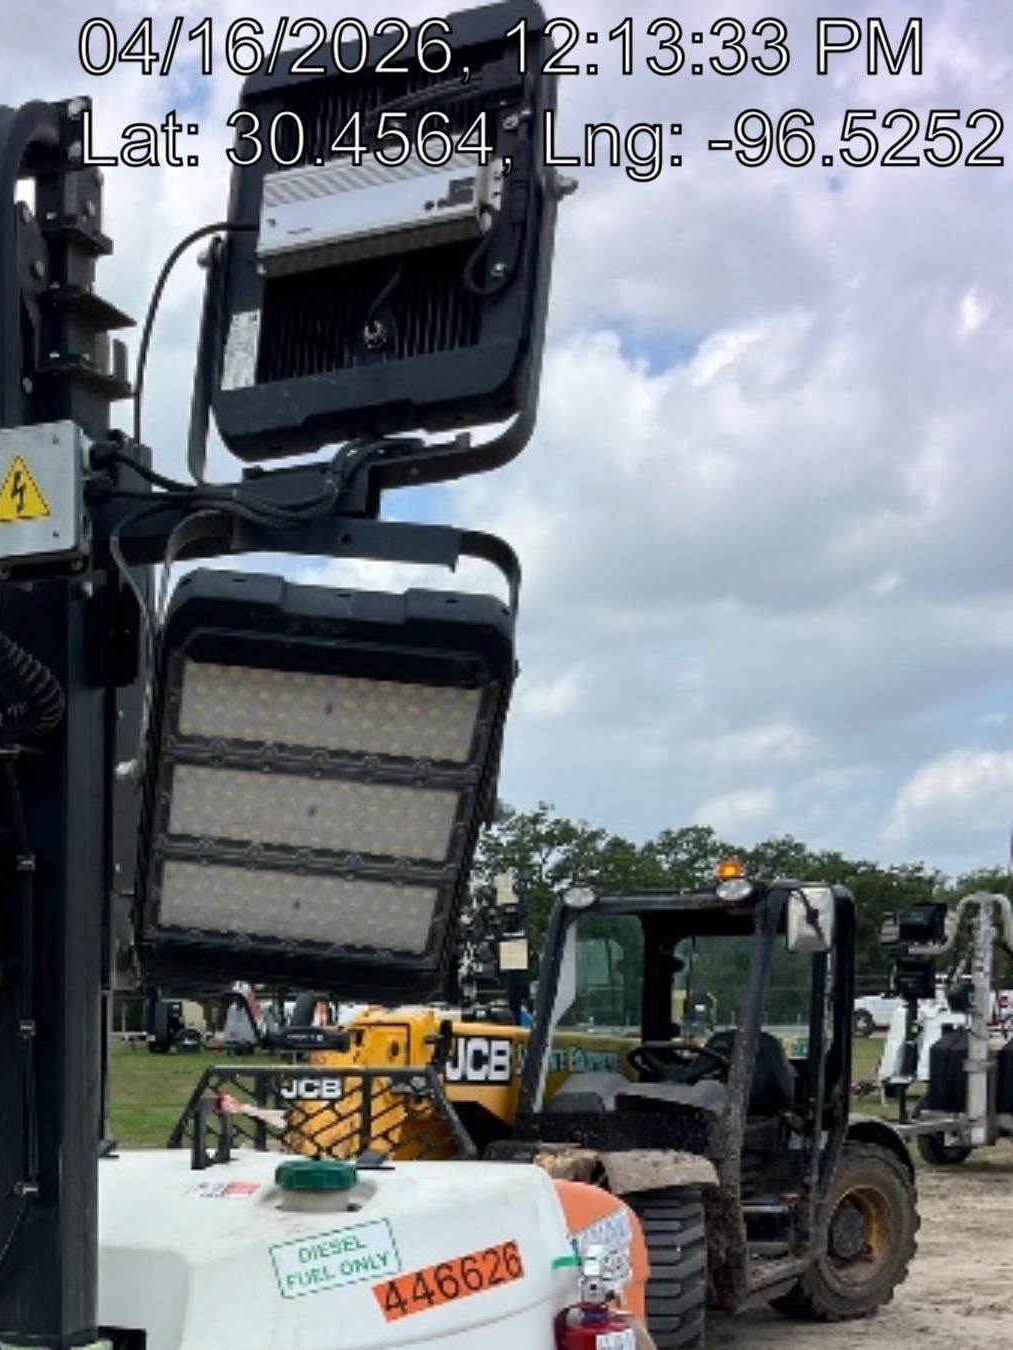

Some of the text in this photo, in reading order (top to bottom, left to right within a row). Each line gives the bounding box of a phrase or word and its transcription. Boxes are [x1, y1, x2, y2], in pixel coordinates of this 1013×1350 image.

[446, 1038, 510, 1081] JCB
[281, 1078, 342, 1099] JCB
[298, 1235, 367, 1265] DIESEL
[287, 1251, 392, 1290] FUEL ONLY
[384, 1241, 525, 1316] 446626
